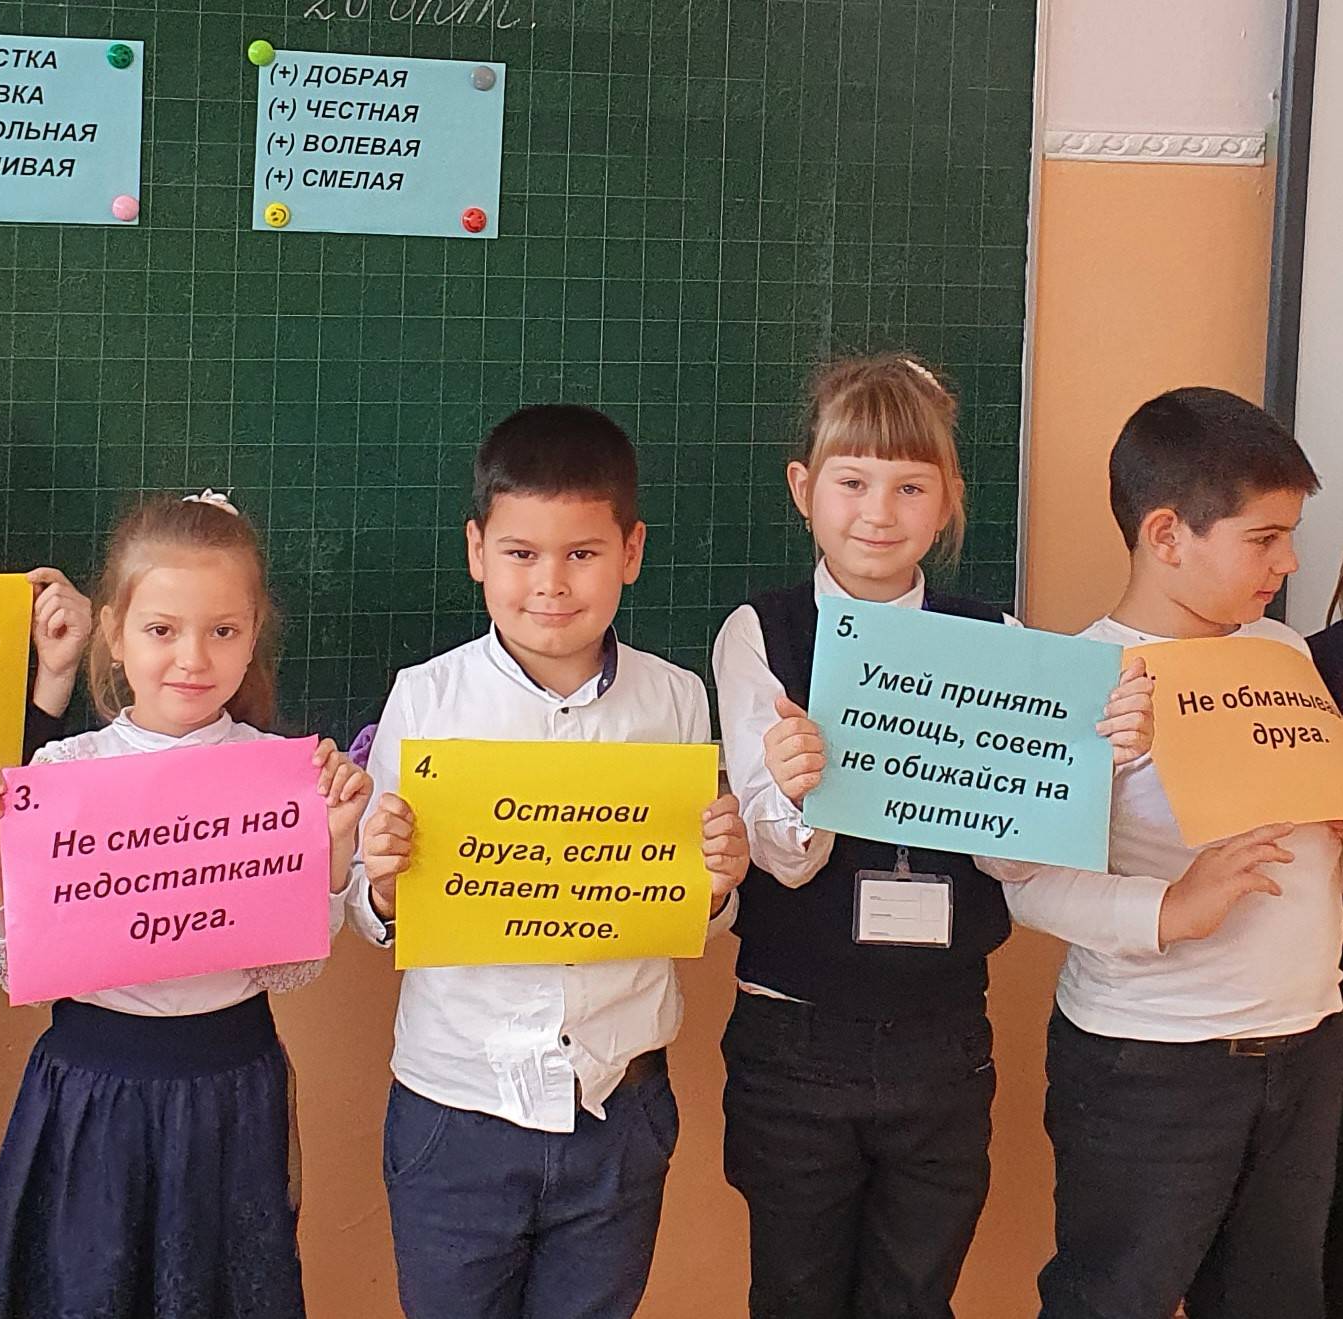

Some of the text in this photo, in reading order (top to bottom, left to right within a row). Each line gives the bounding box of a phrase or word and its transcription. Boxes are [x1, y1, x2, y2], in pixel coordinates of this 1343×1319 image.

[270, 62, 409, 89] (+) ДОБРАЯ
[268, 97, 420, 123] (+) ЧЕСТНАЯ
[267, 132, 421, 158] (+) ВОЛЕВАЯ
[265, 166, 404, 191] (+) СМЕЛАЯ
[836, 614, 858, 639] 5.
[859, 662, 1068, 720] Умей принять
[1177, 691, 1215, 716] Не
[840, 708, 1074, 766] помощь, совет,
[1252, 722, 1330, 750] друга.
[414, 755, 438, 779] 4.
[841, 750, 1069, 801] не обижайся на
[13, 784, 40, 811] 3.
[493, 797, 650, 823] Останови
[52, 801, 300, 859] Не смейся над
[884, 799, 1019, 839] критику.
[458, 835, 677, 866] друга, если он
[52, 852, 305, 905] недостатками
[445, 872, 686, 902] делает что-то
[129, 908, 235, 945] друга.
[504, 919, 619, 939] плохое.
